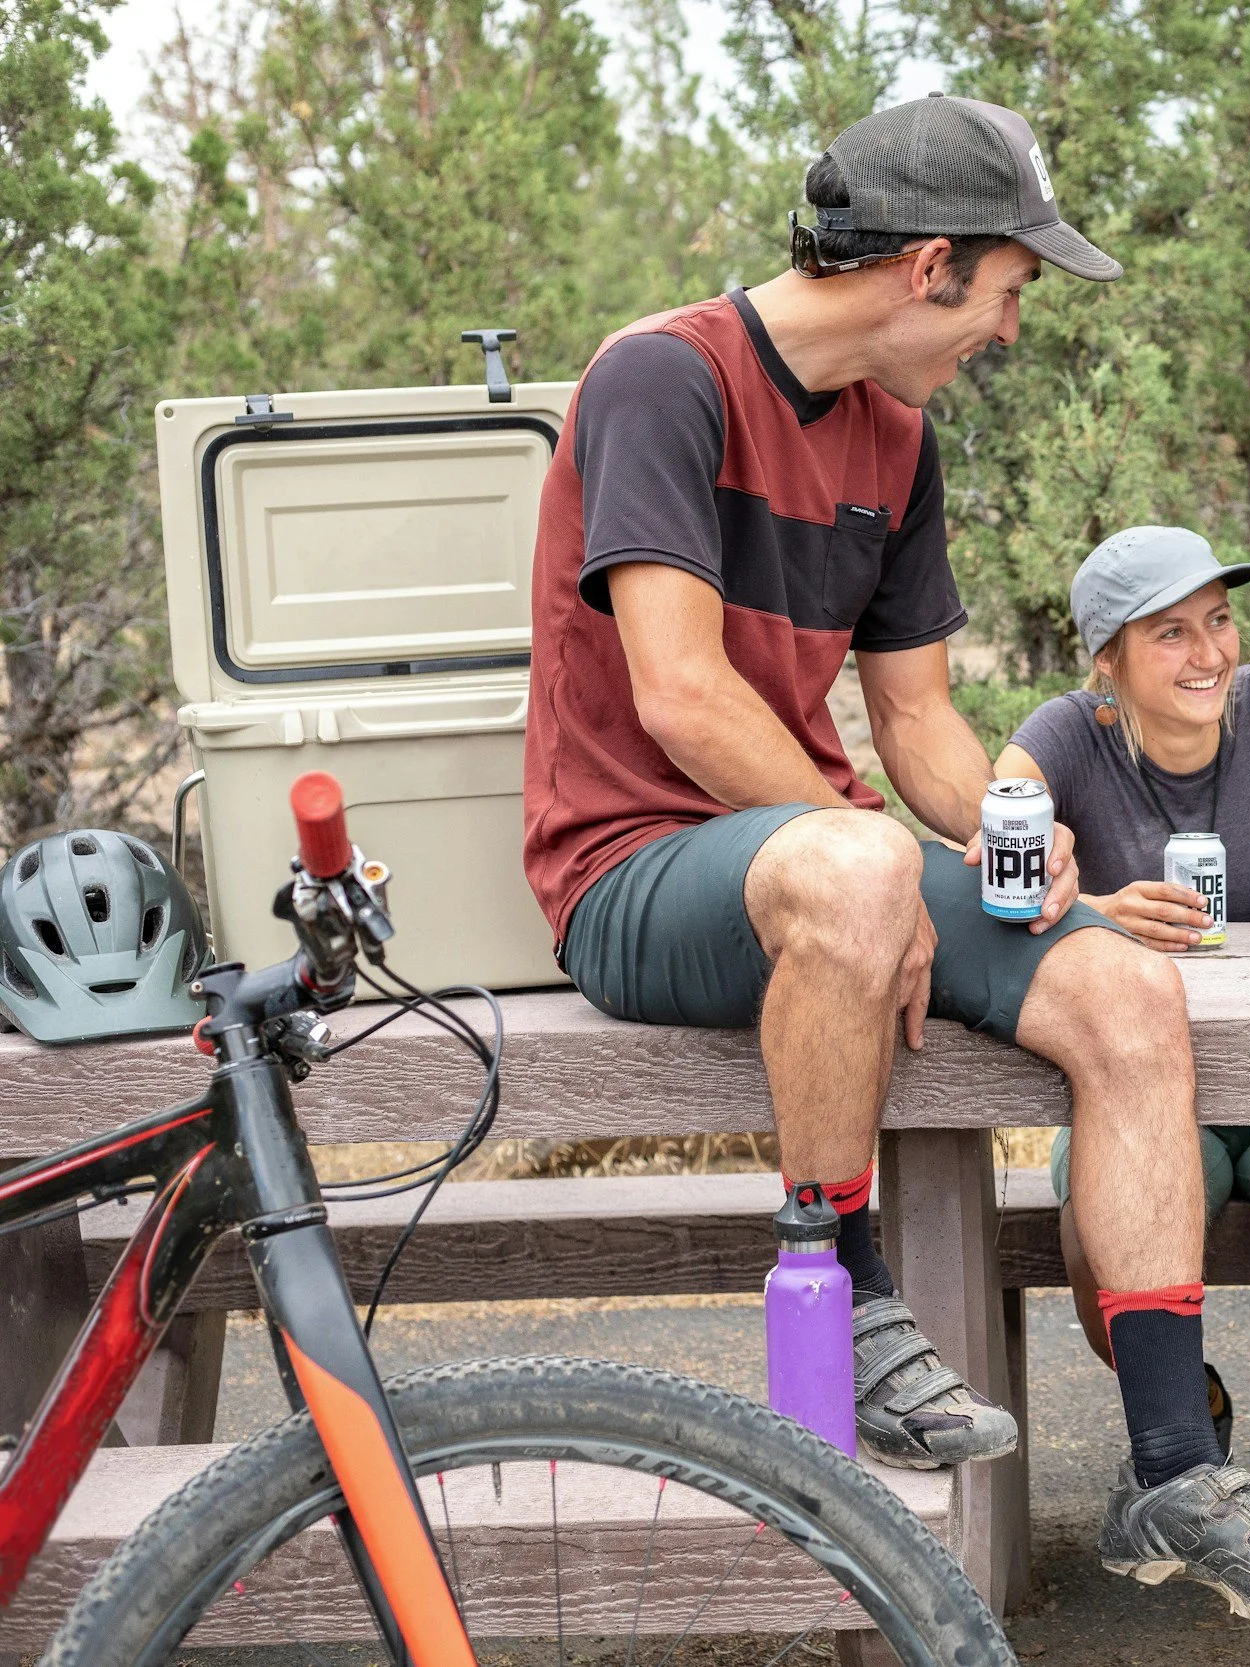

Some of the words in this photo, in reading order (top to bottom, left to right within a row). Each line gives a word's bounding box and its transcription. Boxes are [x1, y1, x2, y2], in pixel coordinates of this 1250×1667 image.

[987, 833, 1045, 850] APOCALYPSE
[987, 846, 1046, 890] IPA
[1190, 874, 1224, 895] JOE
